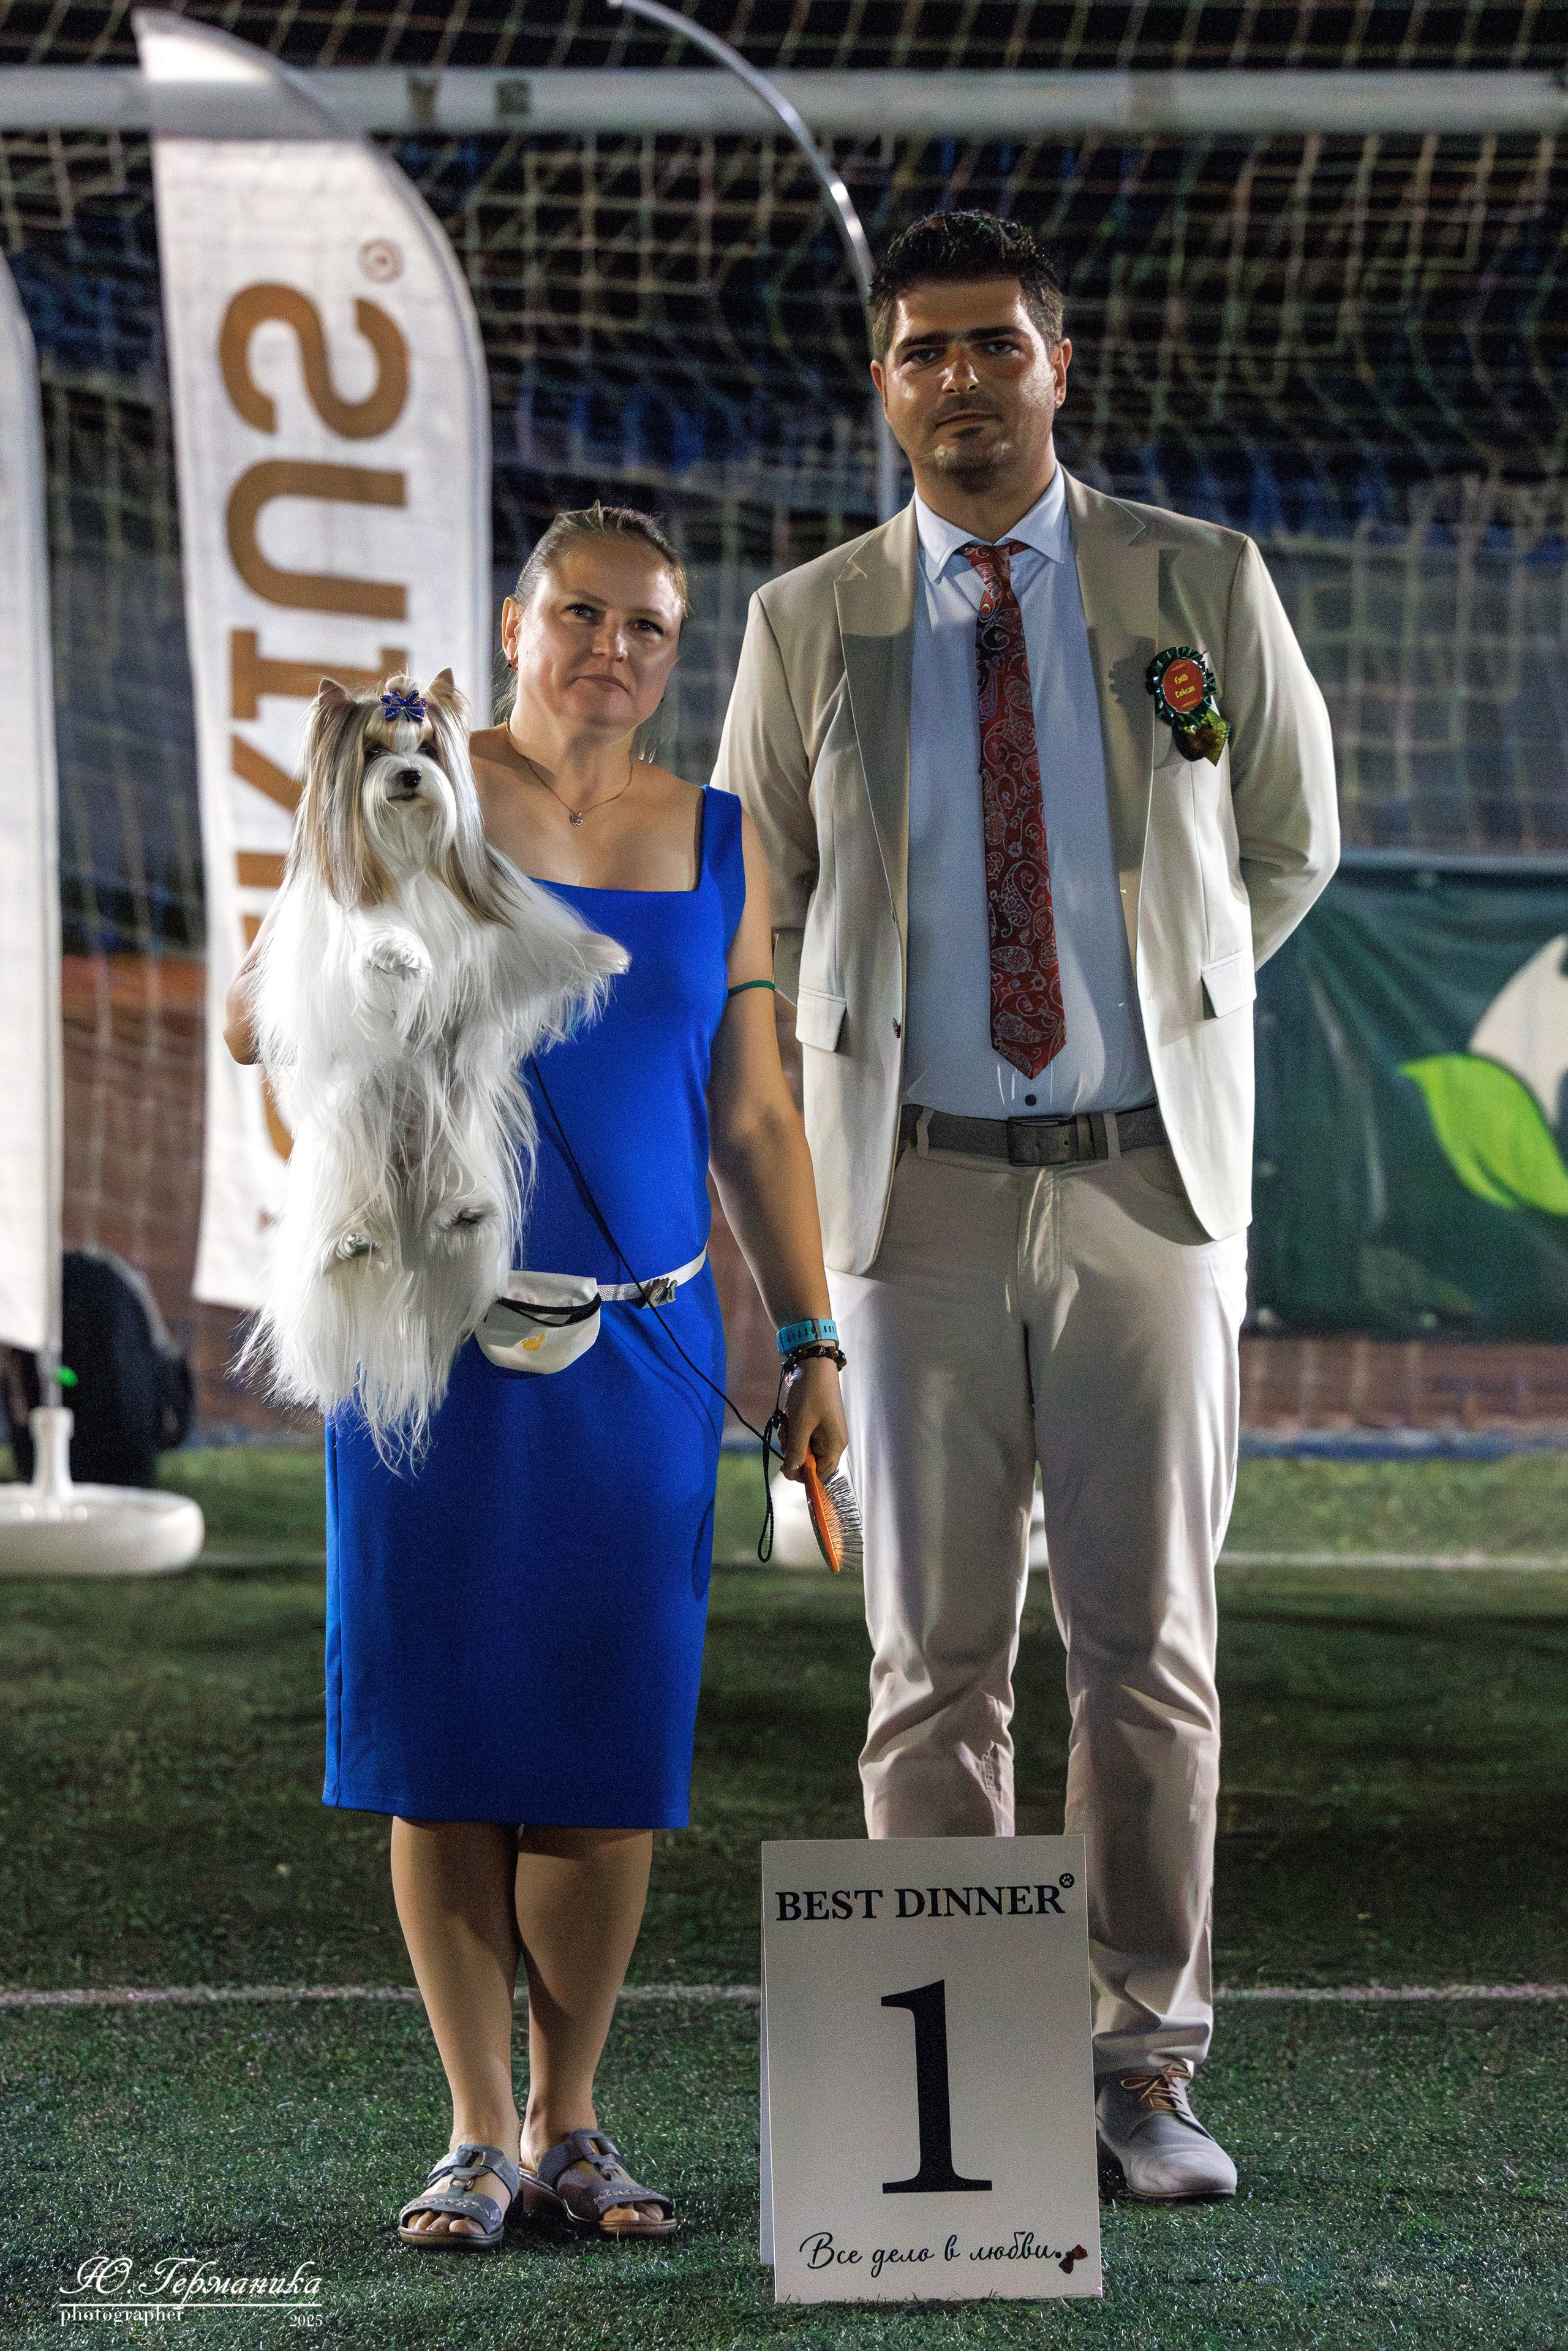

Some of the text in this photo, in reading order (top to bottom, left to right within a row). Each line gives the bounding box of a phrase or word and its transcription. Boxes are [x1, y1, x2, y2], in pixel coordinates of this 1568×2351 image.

[775, 1883, 1066, 1922] BEST DINNER
[880, 1979, 992, 2194] 1
[799, 2231, 863, 2270] Все
[870, 2247, 935, 2279] дело
[944, 2233, 961, 2262] в
